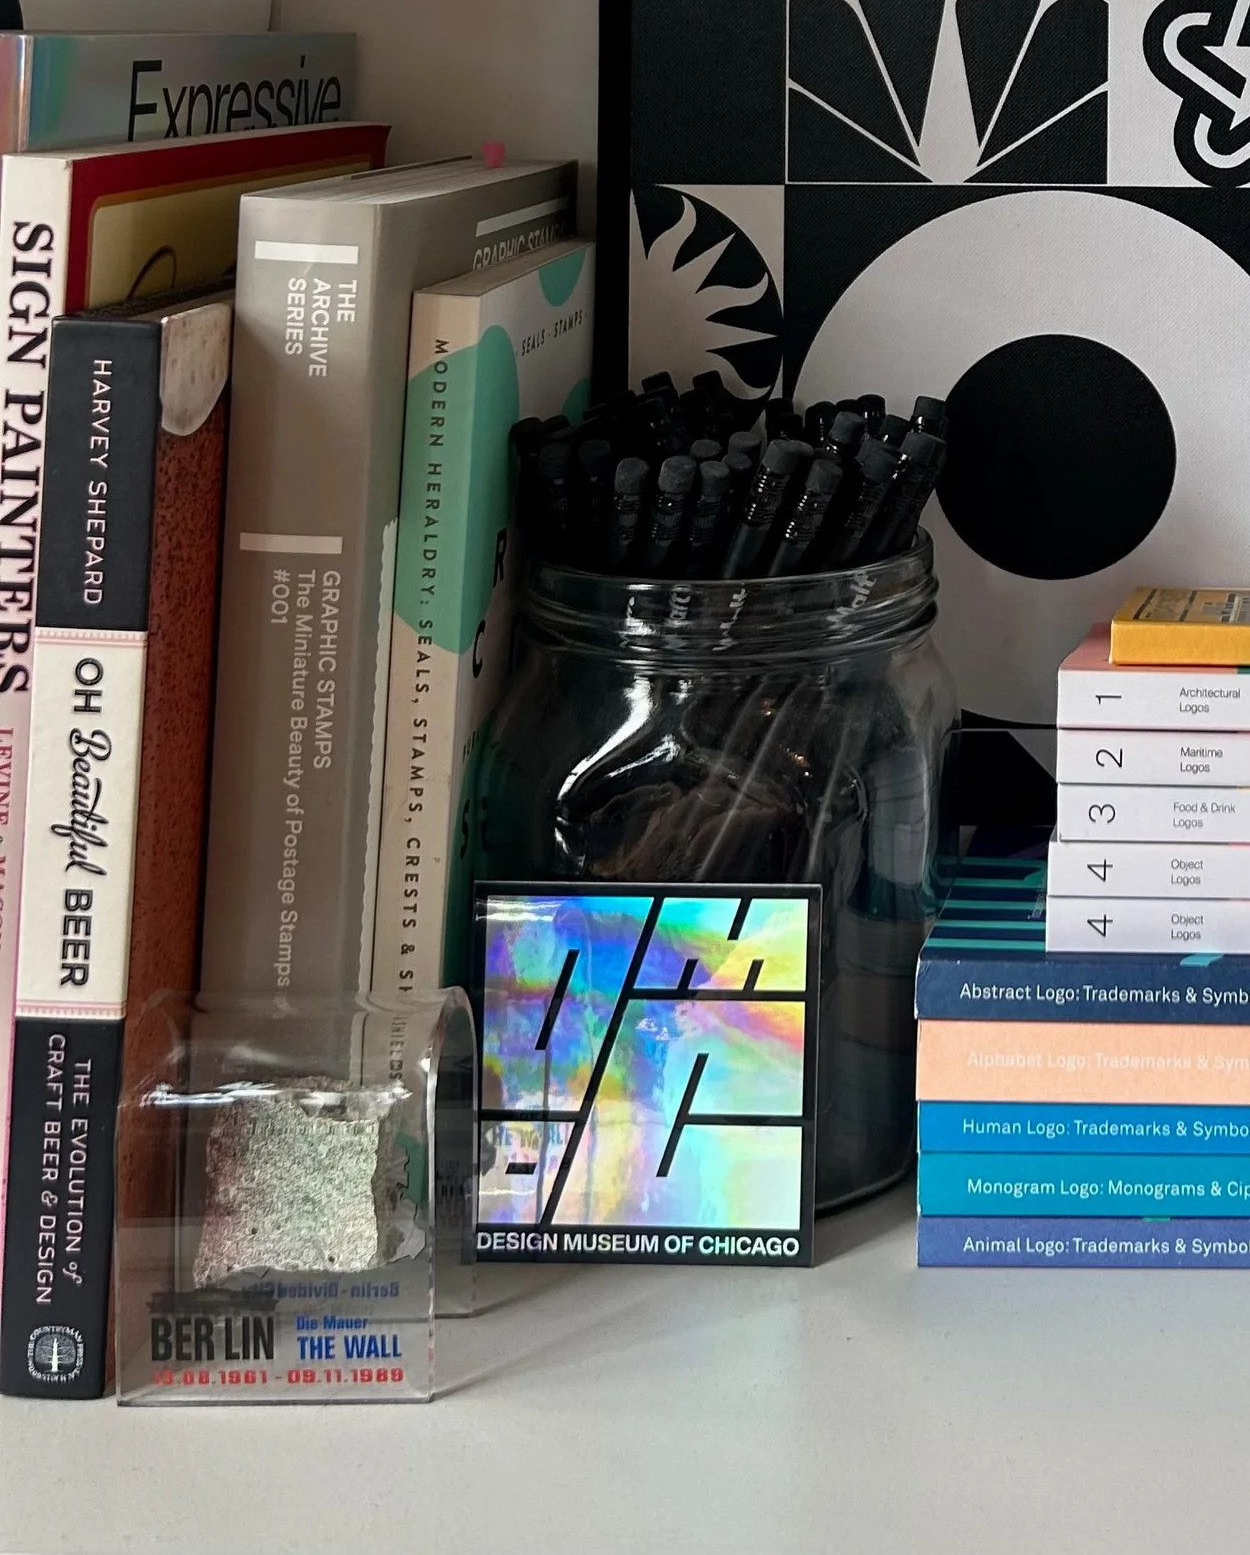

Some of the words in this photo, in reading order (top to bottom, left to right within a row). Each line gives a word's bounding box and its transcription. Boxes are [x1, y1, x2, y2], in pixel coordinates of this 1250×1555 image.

[128, 56, 342, 142] Expressive
[7, 221, 56, 368] SIGN
[285, 277, 307, 355] SERIES
[308, 278, 331, 377] ARCHIVE
[337, 280, 357, 322] THE
[521, 328, 546, 356] SEALS
[553, 309, 583, 338] STAMPS
[88, 358, 113, 469] HARVEY
[428, 339, 449, 447] MODERN
[0, 389, 47, 693] PAINTERS
[84, 481, 108, 605] SHEPARD
[420, 463, 442, 605] HERALDRY:
[270, 569, 291, 625] #001
[297, 569, 316, 608] The
[318, 569, 341, 672] GRAPHIC
[72, 657, 104, 713] OH
[291, 614, 314, 711] Miniature
[410, 619, 434, 704] SEALS,
[1179, 687, 1241, 699] Architectural
[313, 679, 336, 769] STAMPS
[1179, 702, 1209, 714] Logos
[284, 716, 310, 787] Beauty
[404, 718, 428, 824] STAMPS,
[1095, 748, 1123, 768] 2
[1180, 747, 1223, 758] Maritime
[51, 727, 112, 875] Beautiful
[286, 793, 305, 815] of
[279, 819, 303, 904] Postage
[402, 836, 422, 929] CRESTS
[60, 887, 93, 986] BEER
[274, 909, 298, 987] Stamps
[400, 943, 416, 956] &
[960, 983, 1032, 1000] Abstract
[1036, 985, 1080, 1005] Logo:
[1083, 985, 1180, 1003] Trademarks
[1185, 987, 1198, 1003] &
[46, 1033, 66, 1111] CRAFT
[72, 1059, 92, 1113] THE
[42, 1121, 61, 1181] BEER
[65, 1118, 88, 1252] EVOLUTION
[967, 1179, 1055, 1197] Monogram
[1060, 1180, 1103, 1198] Logo:
[1108, 1180, 1205, 1199] Monograms
[1210, 1182, 1222, 1196] &
[41, 1190, 58, 1206] &
[35, 1215, 56, 1304] DESIGN
[62, 1261, 82, 1287] of
[476, 1232, 558, 1252] DESIGN
[563, 1233, 659, 1253] MUSEUM
[664, 1235, 694, 1253] OF
[698, 1235, 800, 1257] CHICAGO
[296, 1315, 318, 1330] Die
[323, 1315, 368, 1330] Mauer
[296, 1336, 336, 1360] THE
[344, 1334, 403, 1358] WALL
